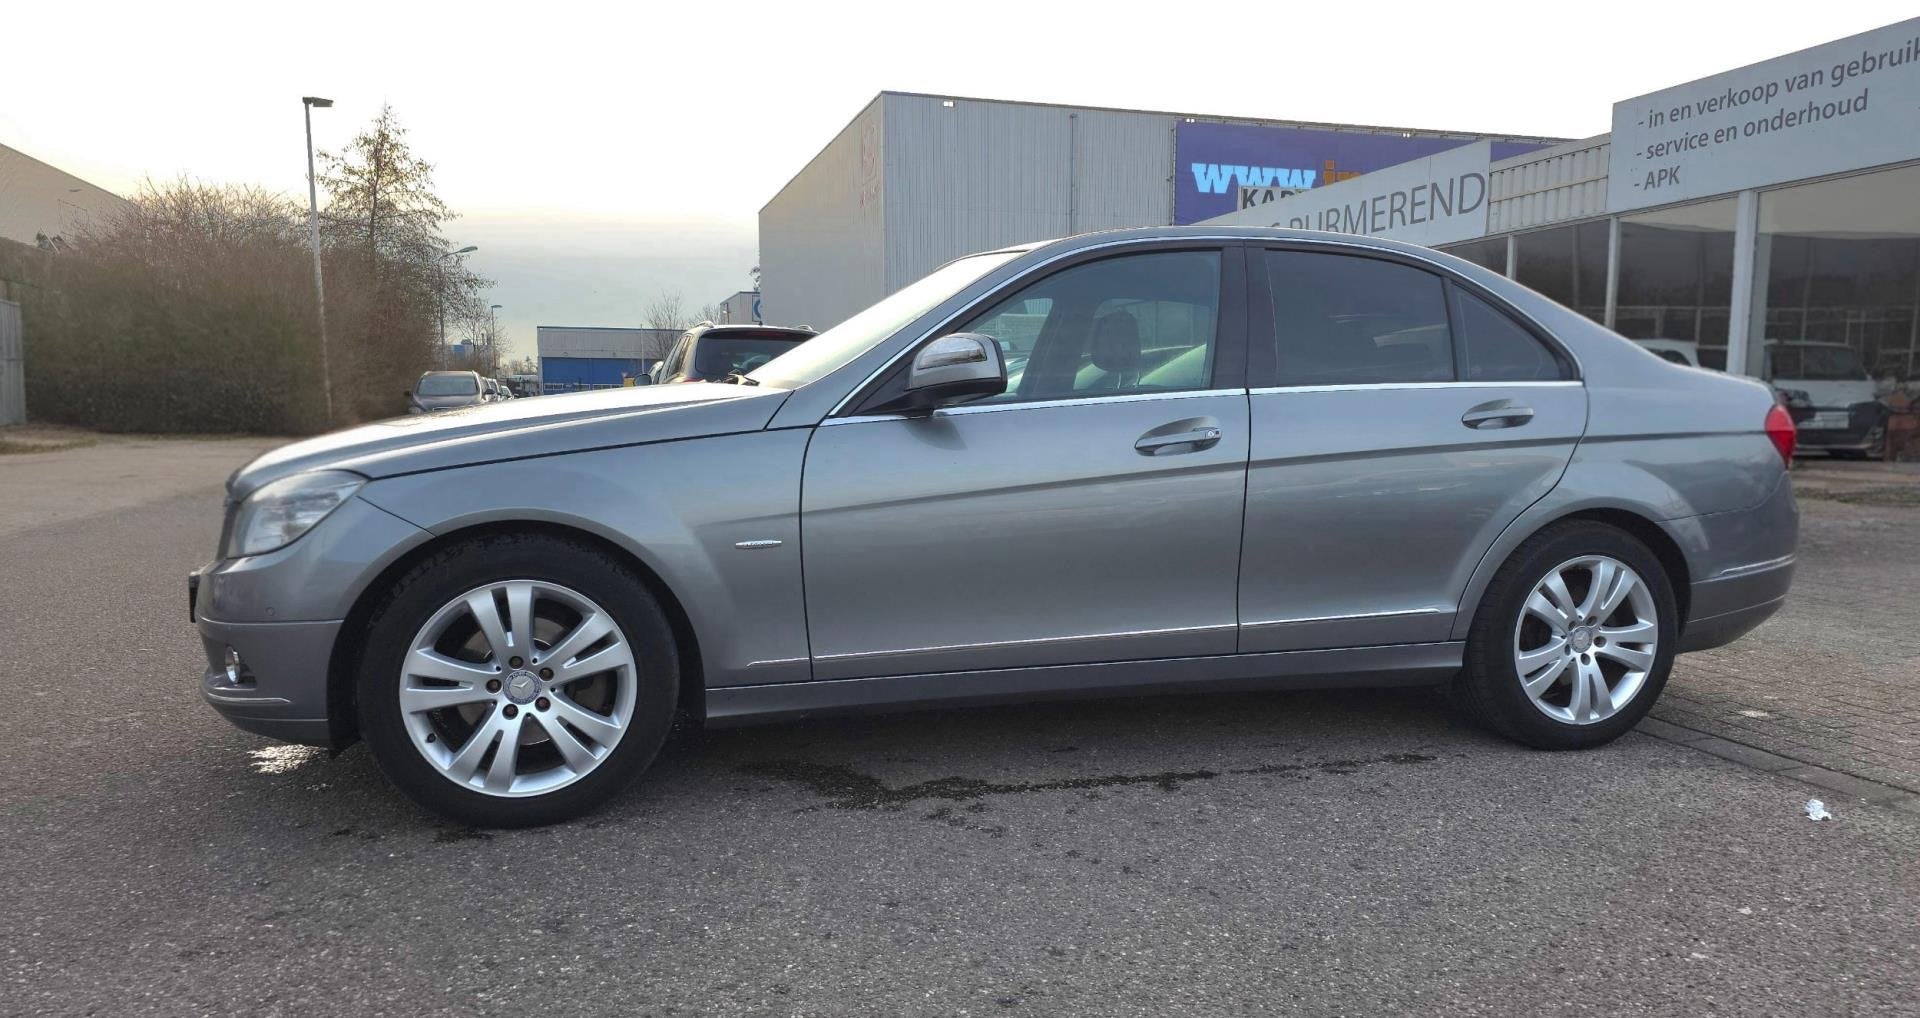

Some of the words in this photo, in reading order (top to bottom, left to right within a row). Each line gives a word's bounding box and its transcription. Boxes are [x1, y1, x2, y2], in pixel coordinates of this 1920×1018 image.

[1646, 132, 1709, 160] service
[1714, 124, 1738, 145] en
[1743, 87, 1869, 137] onderhoud
[1648, 110, 1665, 129] in
[1669, 104, 1692, 123] en
[1696, 81, 1779, 116] verkoop
[1785, 69, 1824, 93] van
[1644, 165, 1681, 191] APK
